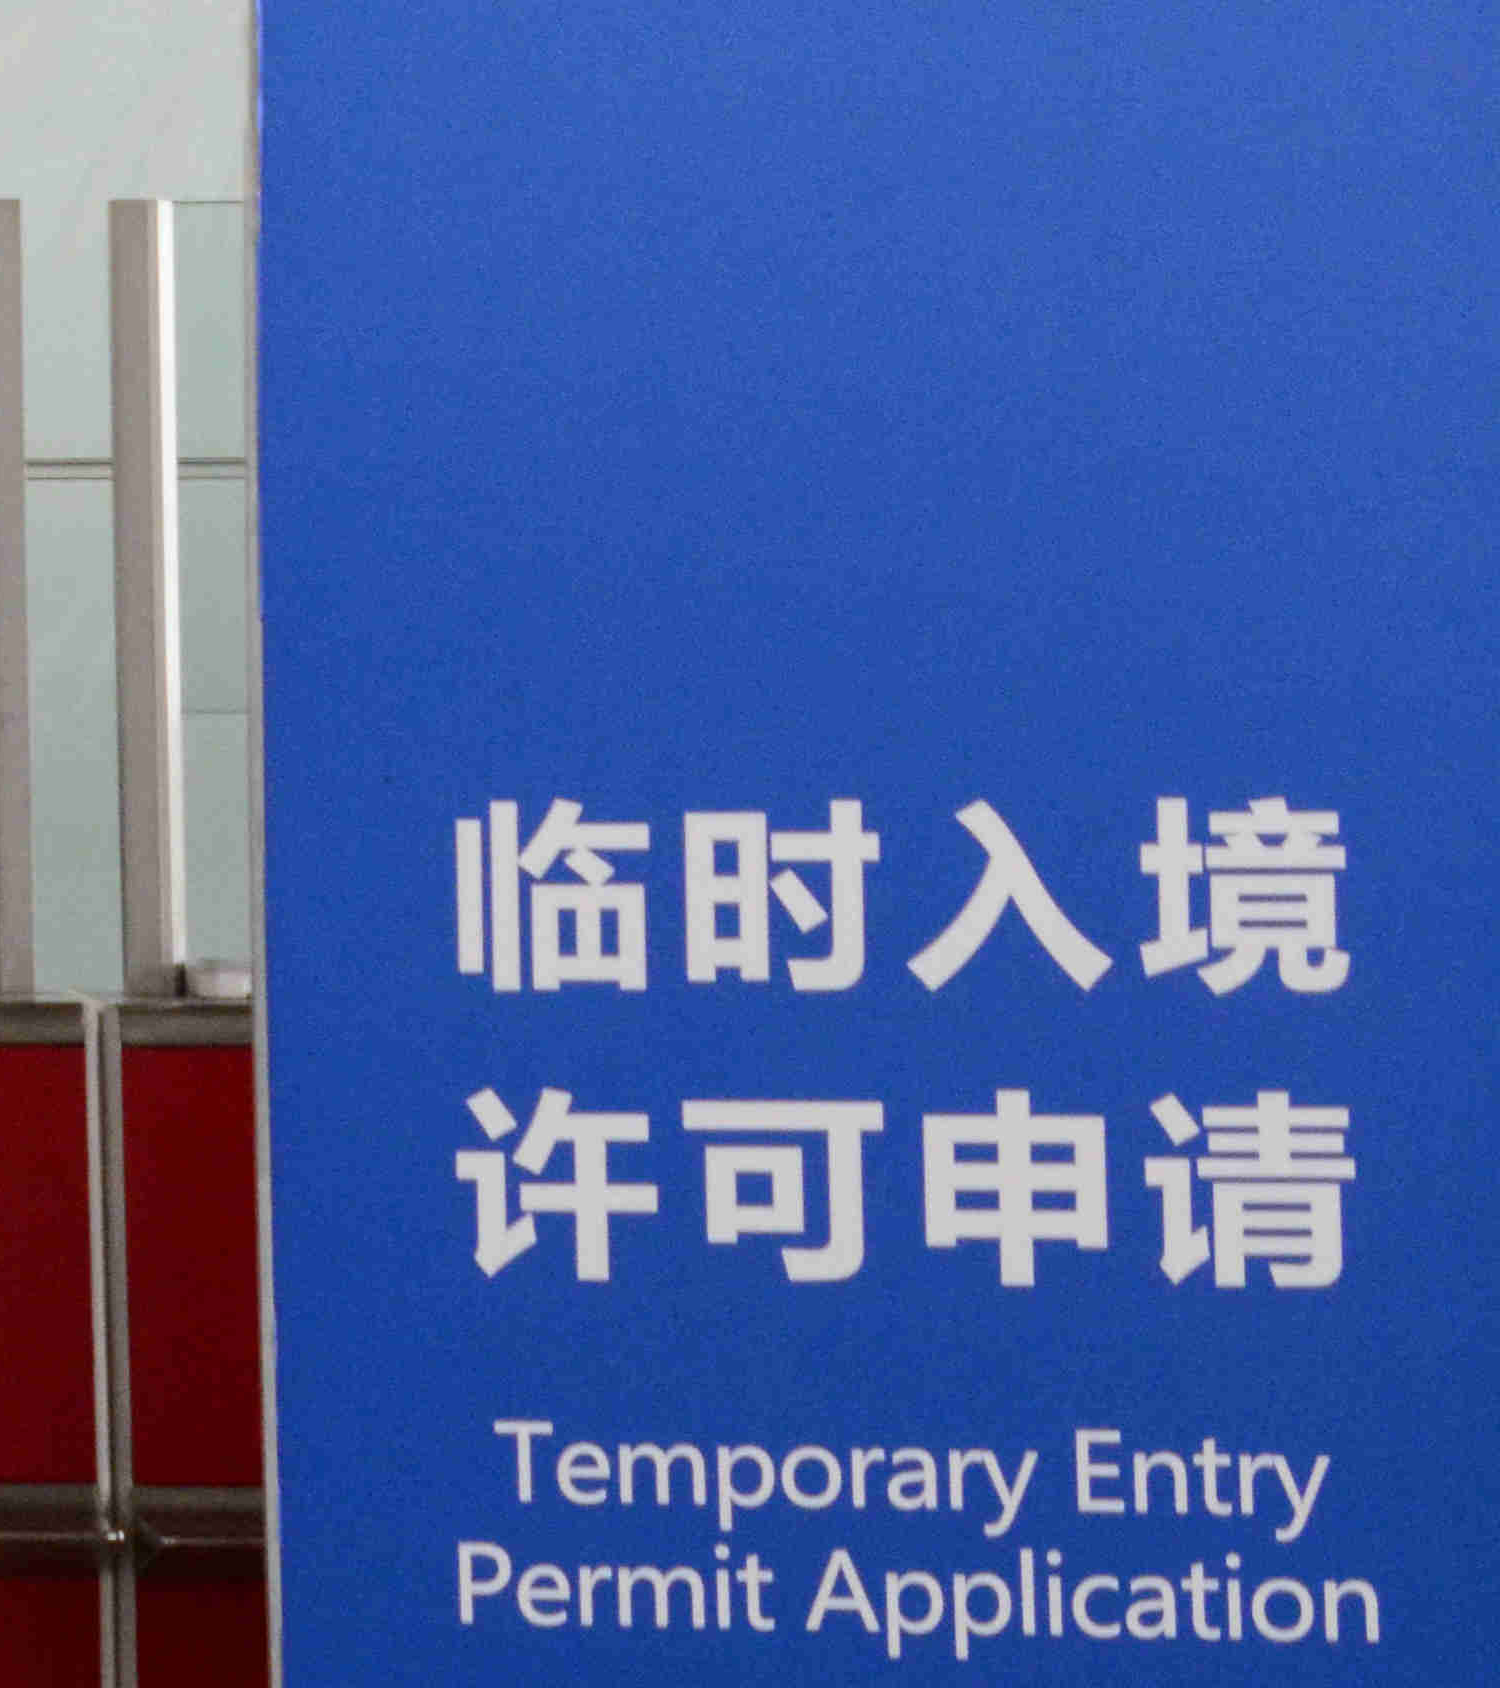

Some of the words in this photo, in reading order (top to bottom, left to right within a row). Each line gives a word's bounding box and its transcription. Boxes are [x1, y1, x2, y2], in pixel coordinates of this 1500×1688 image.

[456, 797, 1350, 995] 临时入境
[456, 1088, 1356, 1288] 许可申请
[494, 1420, 1037, 1537] Temporary
[1076, 1429, 1329, 1540] Entry
[458, 1542, 774, 1631] Permit
[806, 1548, 1379, 1660] Application
